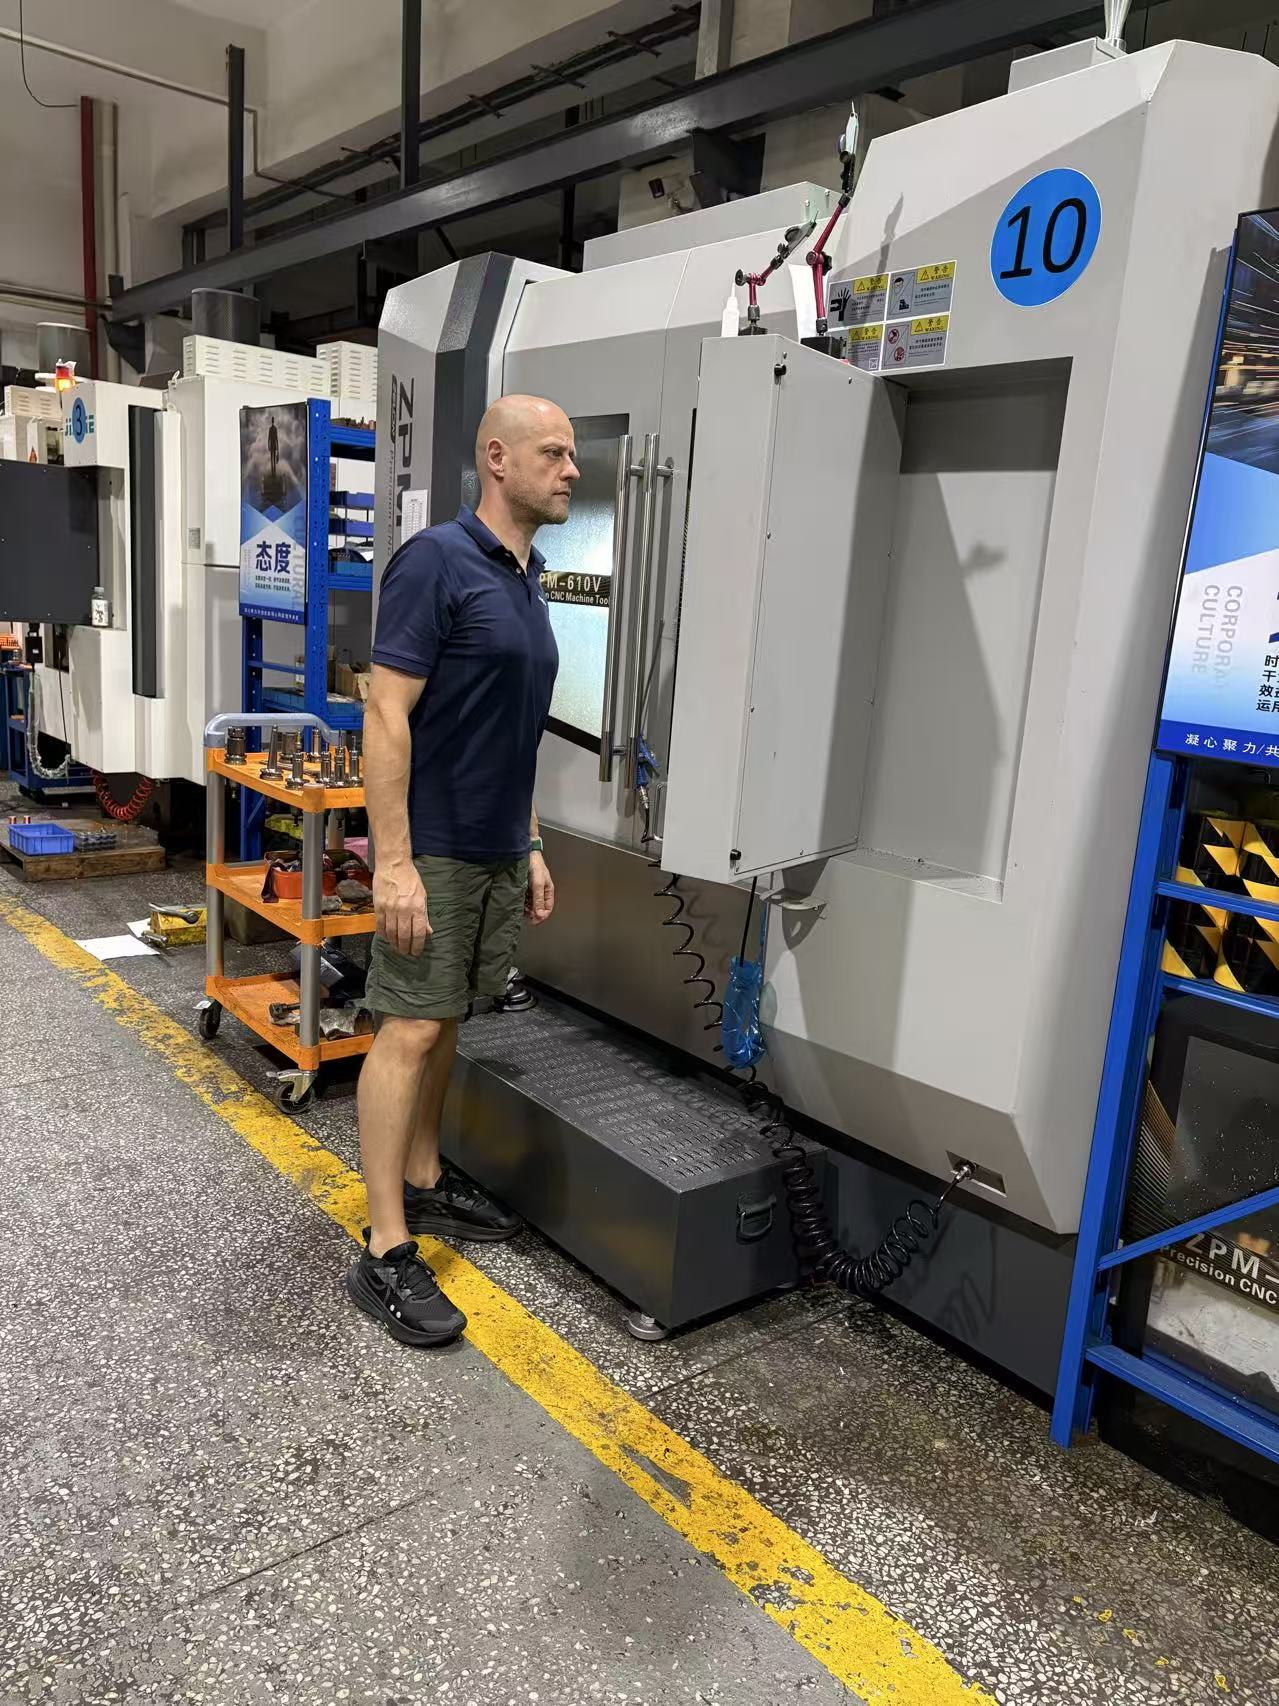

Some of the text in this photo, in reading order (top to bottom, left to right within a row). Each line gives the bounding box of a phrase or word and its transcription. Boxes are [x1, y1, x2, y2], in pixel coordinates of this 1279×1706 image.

[1000, 198, 1086, 279] 10
[75, 404, 83, 436] 3
[256, 540, 291, 574] 态度
[551, 591, 565, 600] CNC
[566, 592, 594, 603] Machine
[1192, 585, 1220, 674] CULTURE
[1240, 1278, 1278, 1305] CNC
